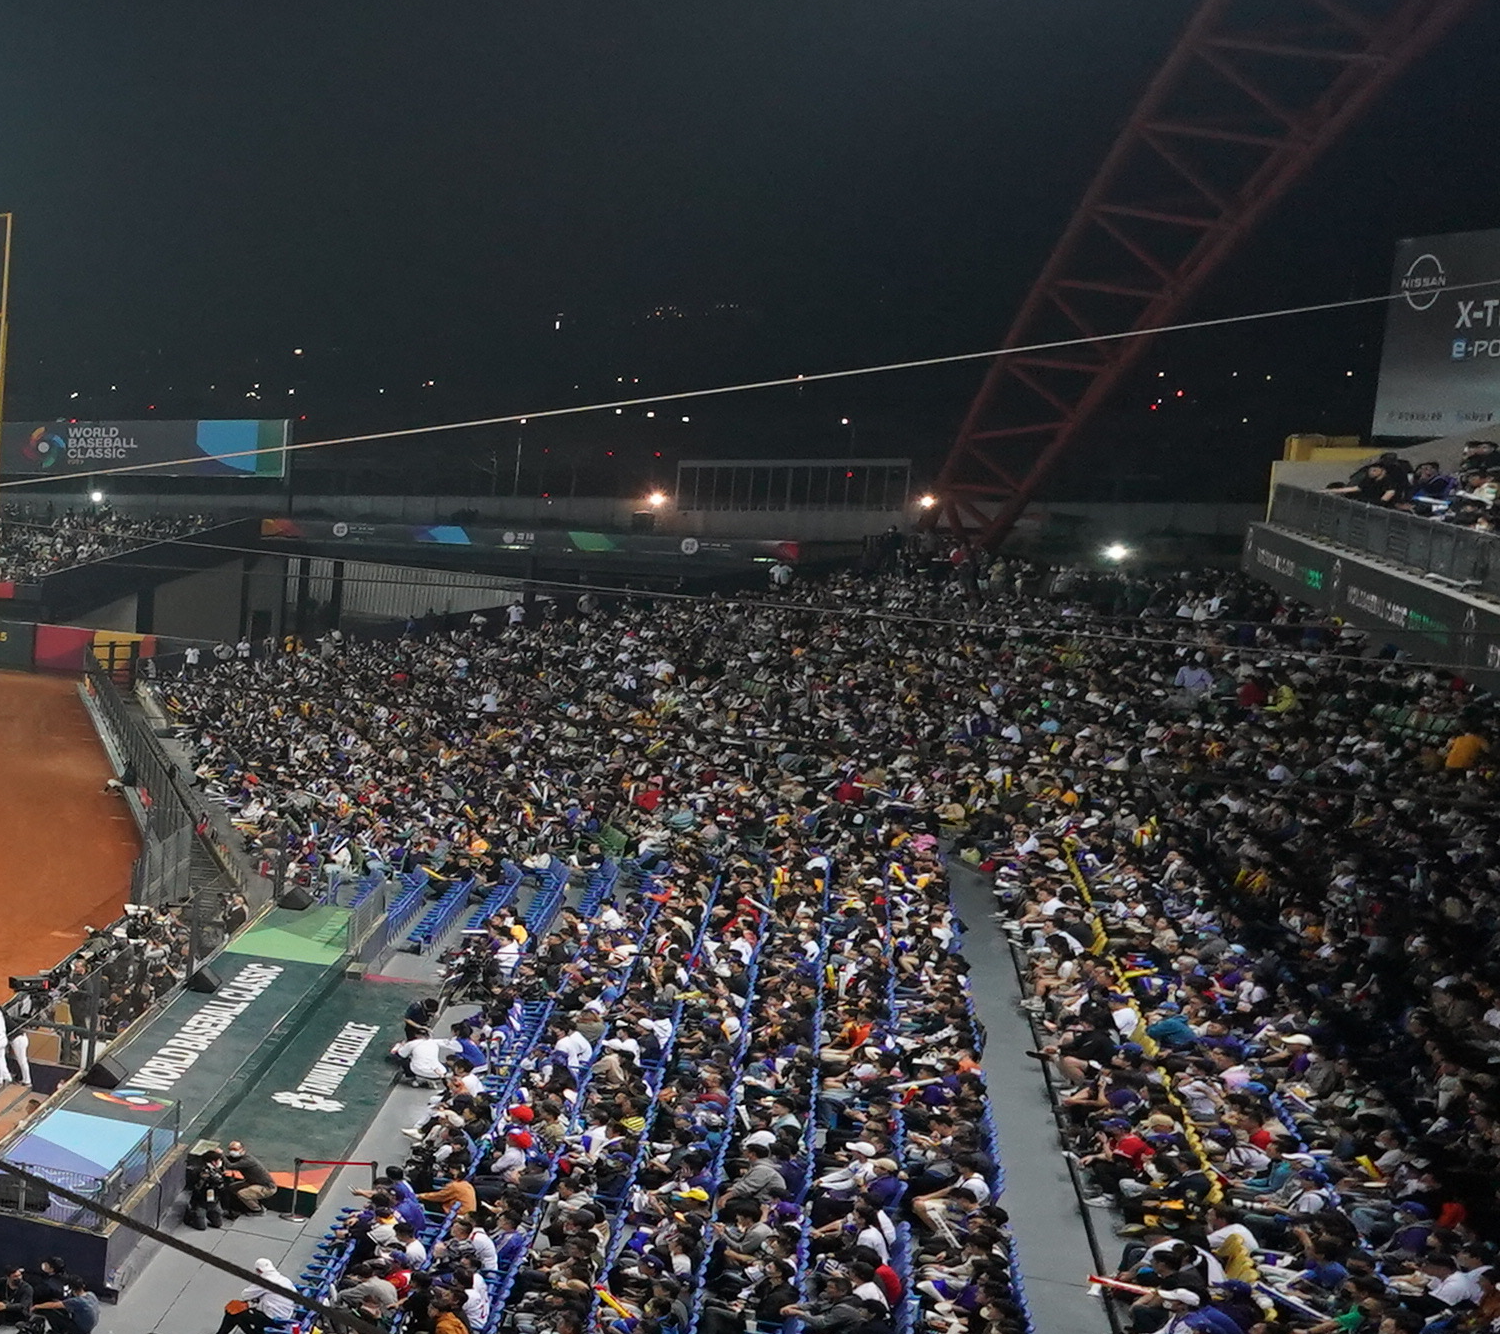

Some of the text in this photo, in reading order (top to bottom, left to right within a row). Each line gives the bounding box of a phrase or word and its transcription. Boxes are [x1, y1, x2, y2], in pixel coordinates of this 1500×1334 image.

[1402, 276, 1446, 289] NISSAN
[1455, 300, 1500, 330] X-T
[68, 427, 119, 438] WORLD
[68, 437, 138, 448] BASEBALL
[67, 448, 126, 458] CLASSIC
[126, 963, 285, 1093] WORLD BASEBALL CLASSIC
